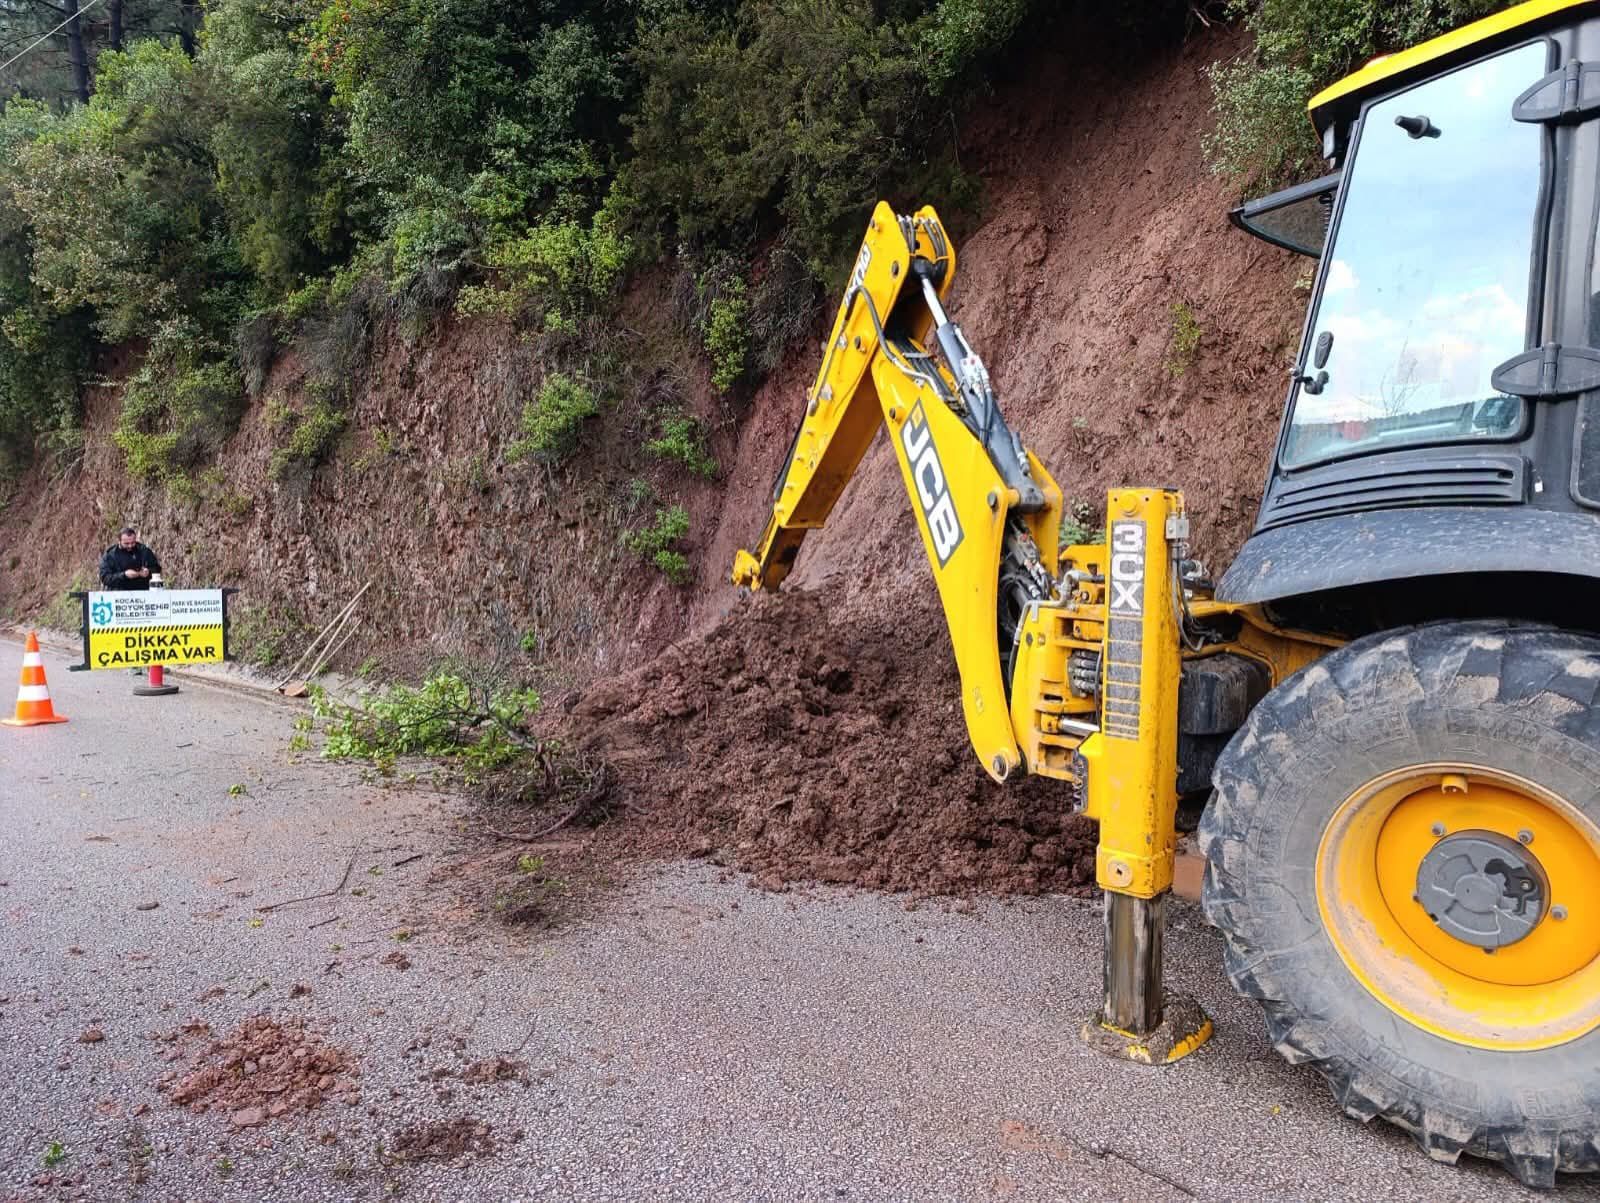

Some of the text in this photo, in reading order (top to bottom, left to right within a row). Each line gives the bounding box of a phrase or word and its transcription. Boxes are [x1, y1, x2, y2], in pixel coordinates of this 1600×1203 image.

[903, 418, 960, 561] JCB
[1111, 524, 1144, 609] 3CX
[98, 646, 216, 666] ÇALIŞMA VAR
[125, 633, 191, 648] DİKKAT
